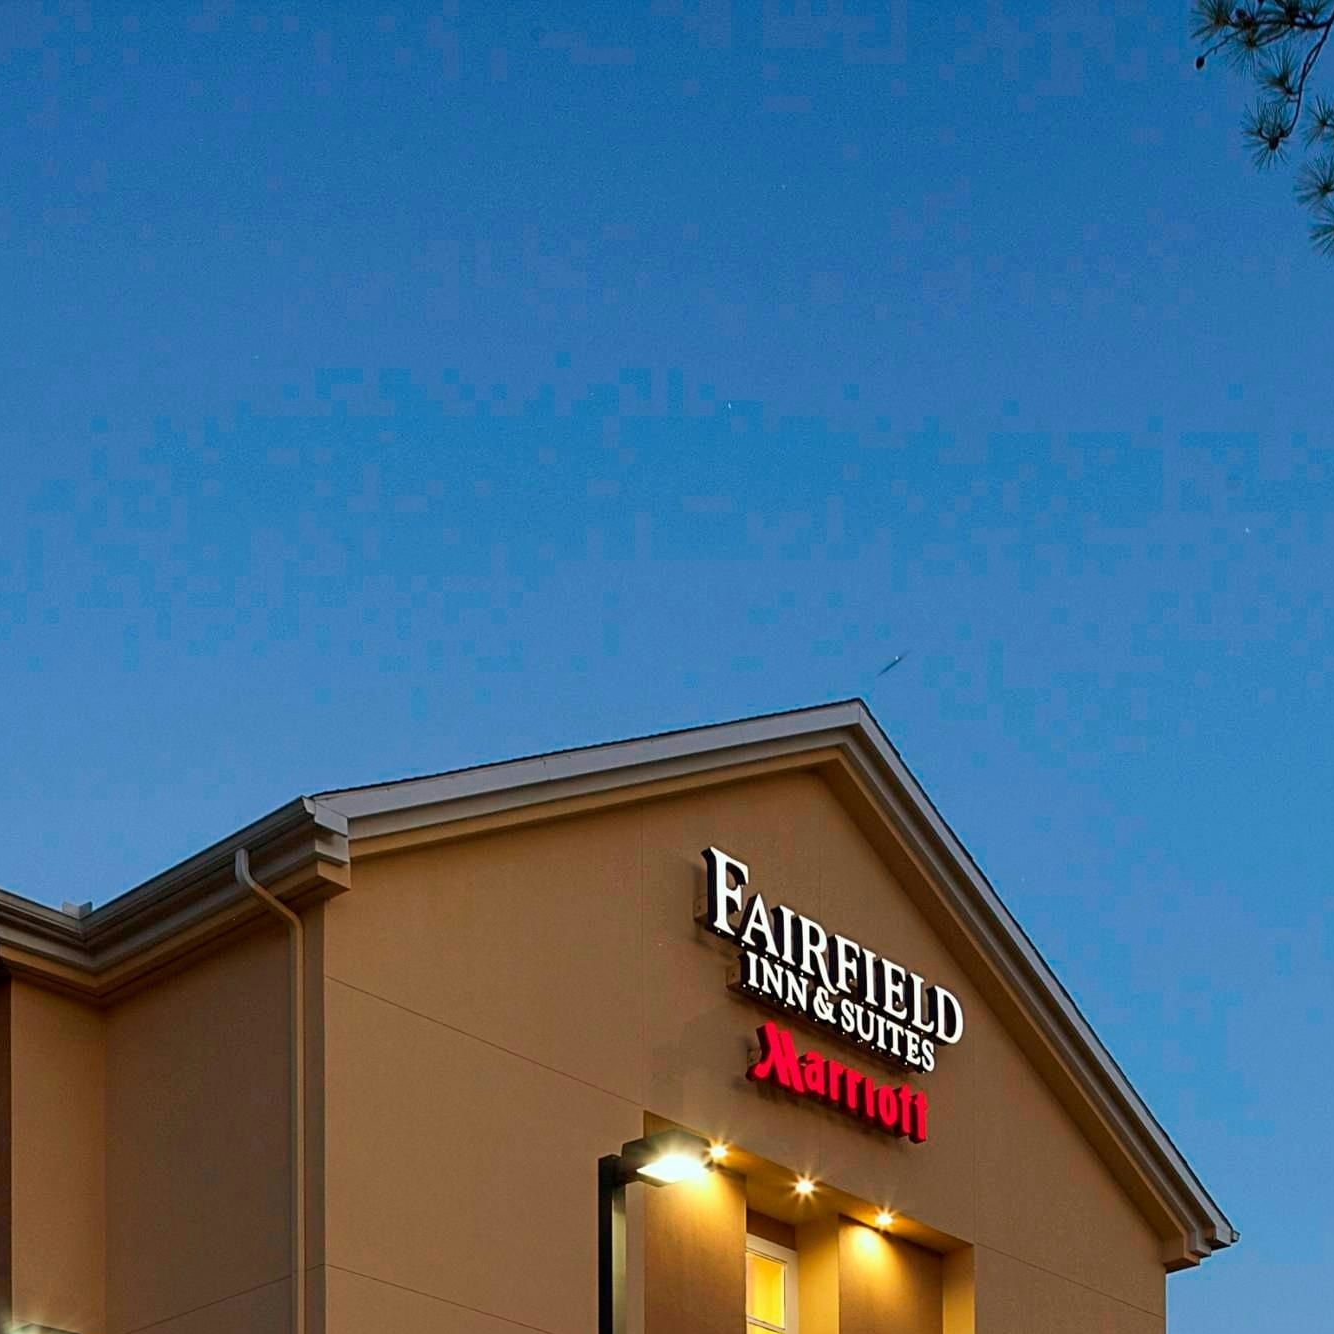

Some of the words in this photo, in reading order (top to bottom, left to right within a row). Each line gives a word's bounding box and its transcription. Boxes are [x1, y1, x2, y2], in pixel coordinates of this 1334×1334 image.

[709, 845, 965, 1045] FAIRFIELD
[746, 950, 809, 1012] INN
[812, 985, 837, 1025] &
[840, 998, 936, 1073] SUITES
[750, 1019, 929, 1142] Marriott
